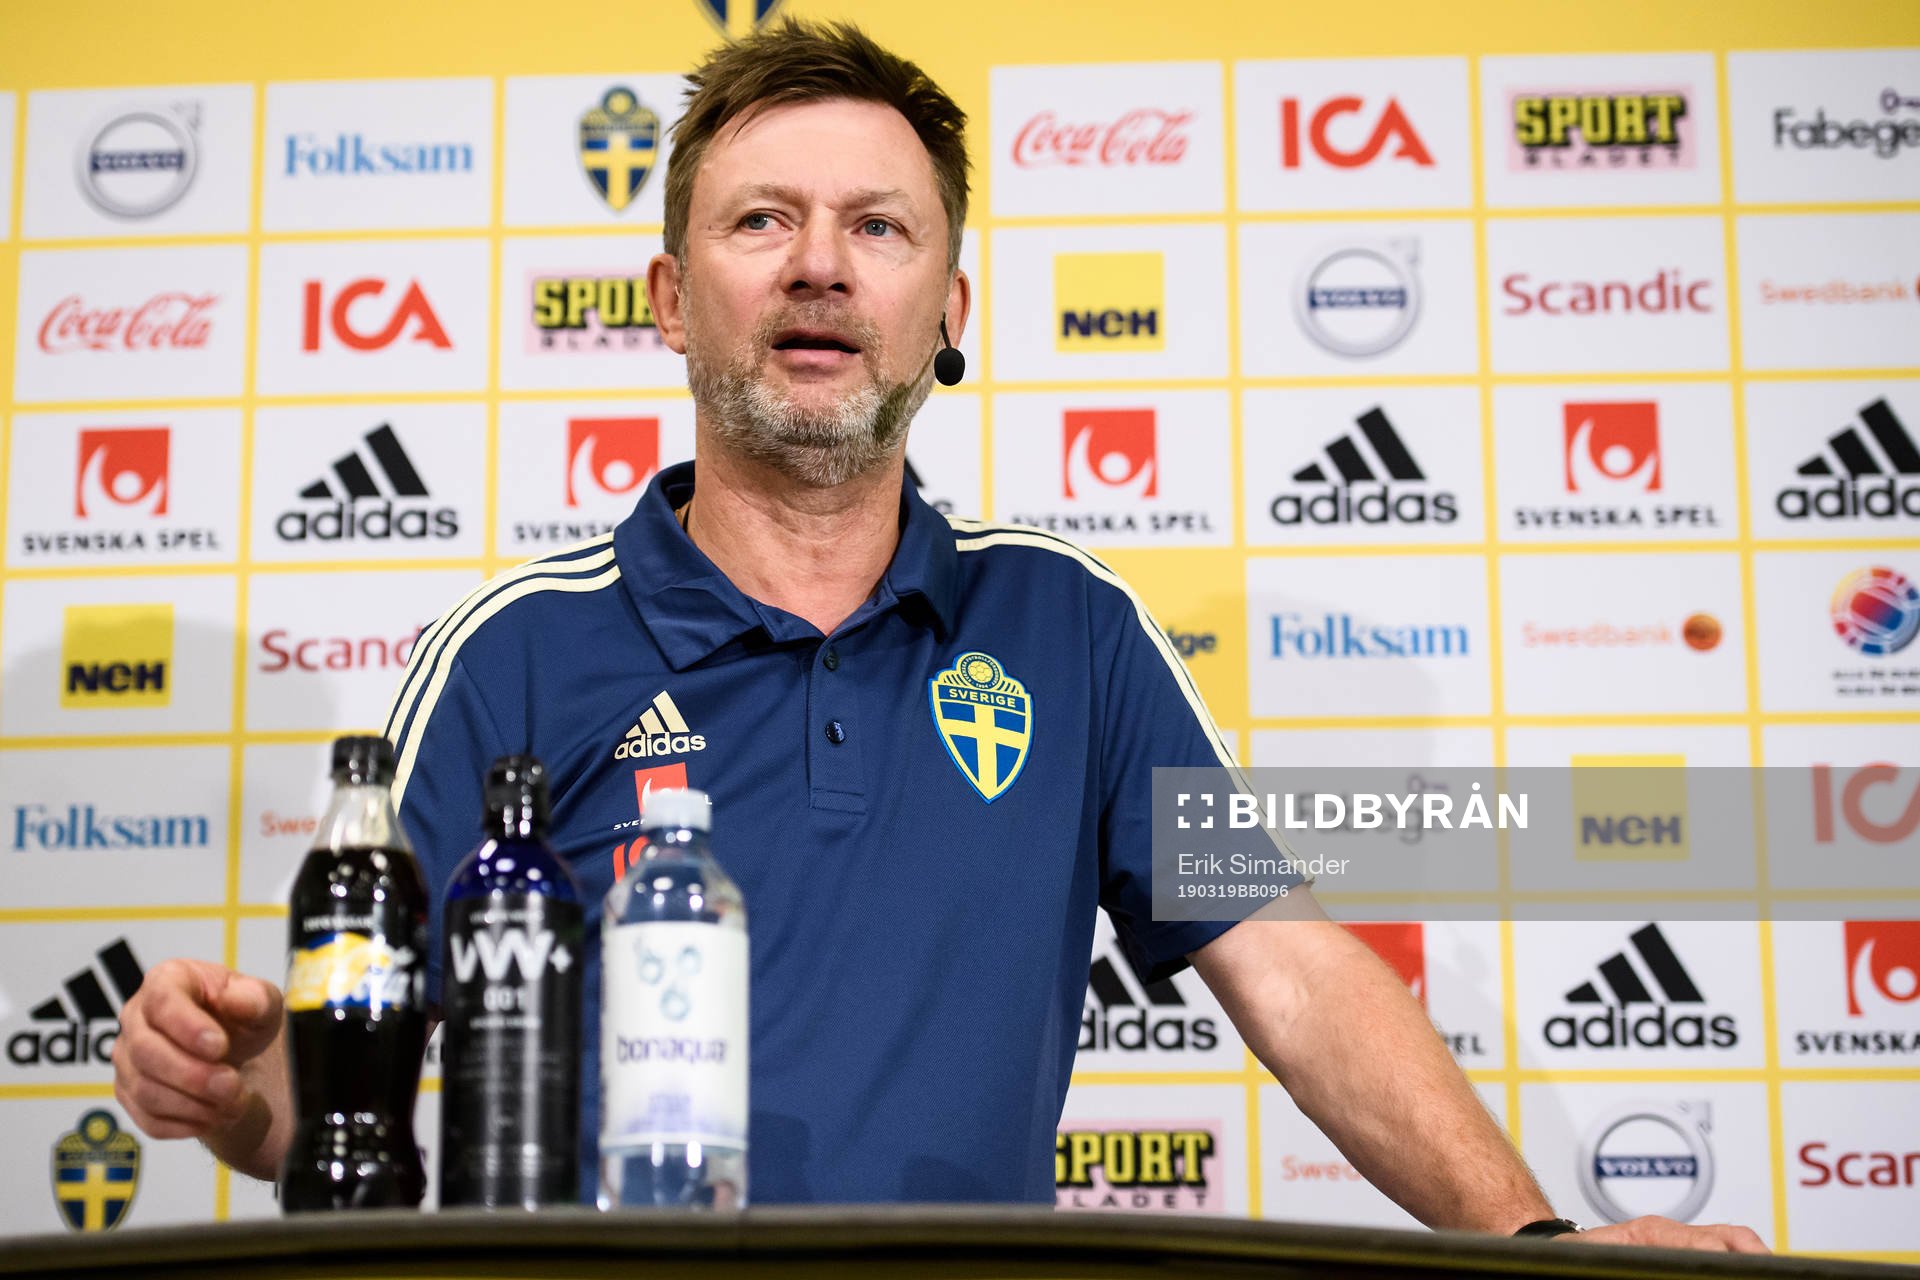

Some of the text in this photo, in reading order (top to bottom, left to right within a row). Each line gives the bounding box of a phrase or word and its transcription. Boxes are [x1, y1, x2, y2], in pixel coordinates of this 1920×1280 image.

[1281, 96, 1435, 169] ICA
[1515, 95, 1688, 148] SPORT
[285, 134, 472, 176] Folksam
[534, 277, 654, 328] SPOR
[1503, 270, 1710, 315] Scandic
[1760, 280, 1908, 305] Swedbank
[303, 278, 452, 352] ICA
[276, 497, 459, 542] adidas
[1150, 512, 1214, 532] SPEL
[1271, 482, 1458, 525] adidas
[1516, 506, 1719, 527] SVENSKA SPEL
[24, 530, 220, 553] SVENSKA SPEL
[259, 626, 421, 674] Scand
[1271, 614, 1467, 658] Folksam
[1522, 623, 1674, 648] Swedbank
[949, 688, 1017, 708] SVERIGE
[614, 732, 707, 760] adidas
[1811, 762, 1920, 844] IC
[14, 805, 208, 851] Folksam
[8, 1021, 121, 1064] adid
[1078, 1008, 1218, 1052] didas
[1544, 1002, 1739, 1048] adidas
[1600, 1159, 1694, 1175] VOLVO
[1056, 1193, 1207, 1208] LADET
